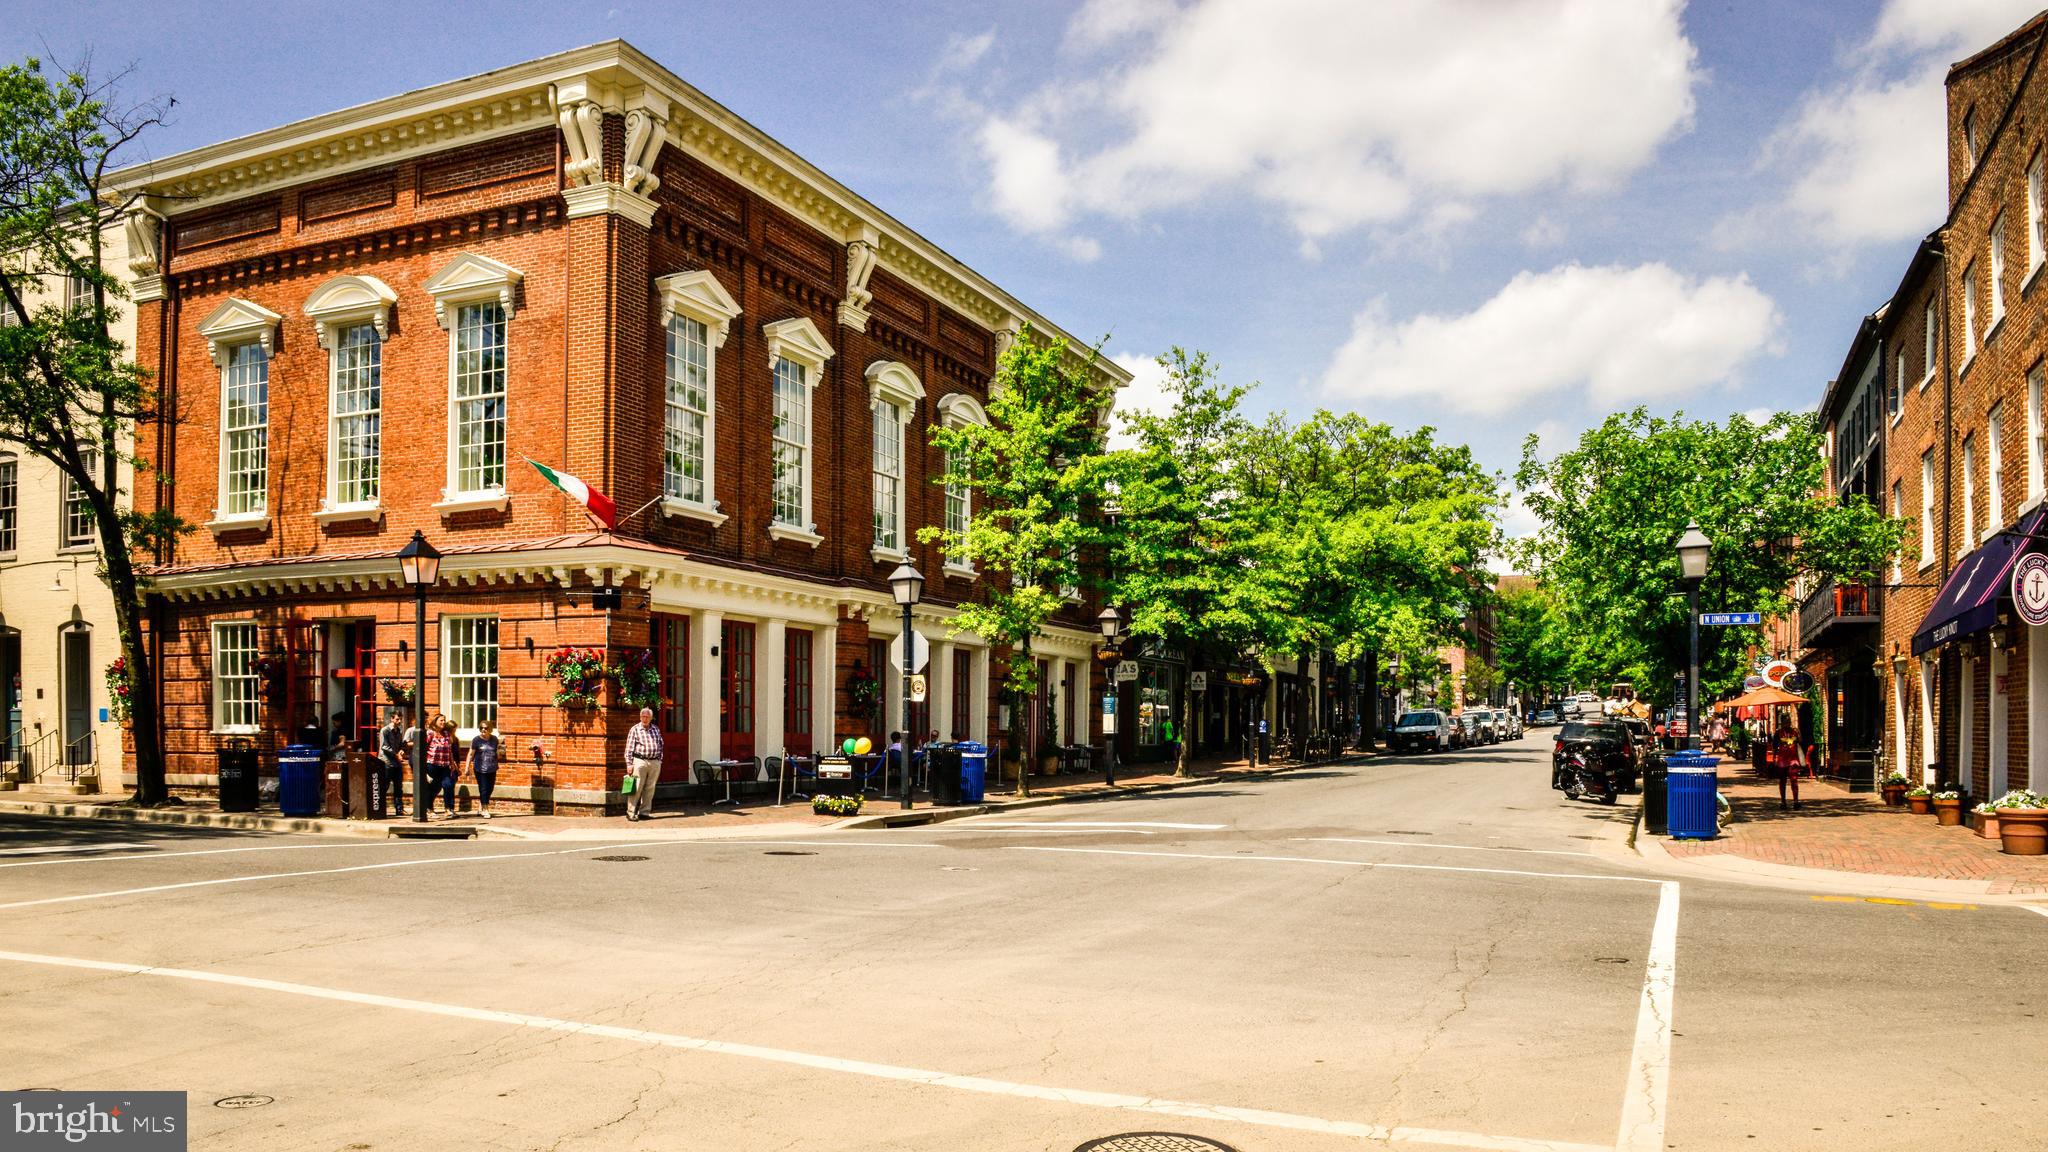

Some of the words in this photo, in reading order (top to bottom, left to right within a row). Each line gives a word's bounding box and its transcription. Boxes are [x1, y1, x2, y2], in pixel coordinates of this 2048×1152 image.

[2019, 565, 2028, 579] THE
[2026, 558, 2044, 570] LUCKY
[1705, 615, 1709, 623] N
[1711, 615, 1730, 623] UNION
[1949, 620, 1958, 636] KNOT
[371, 772, 380, 810] express
